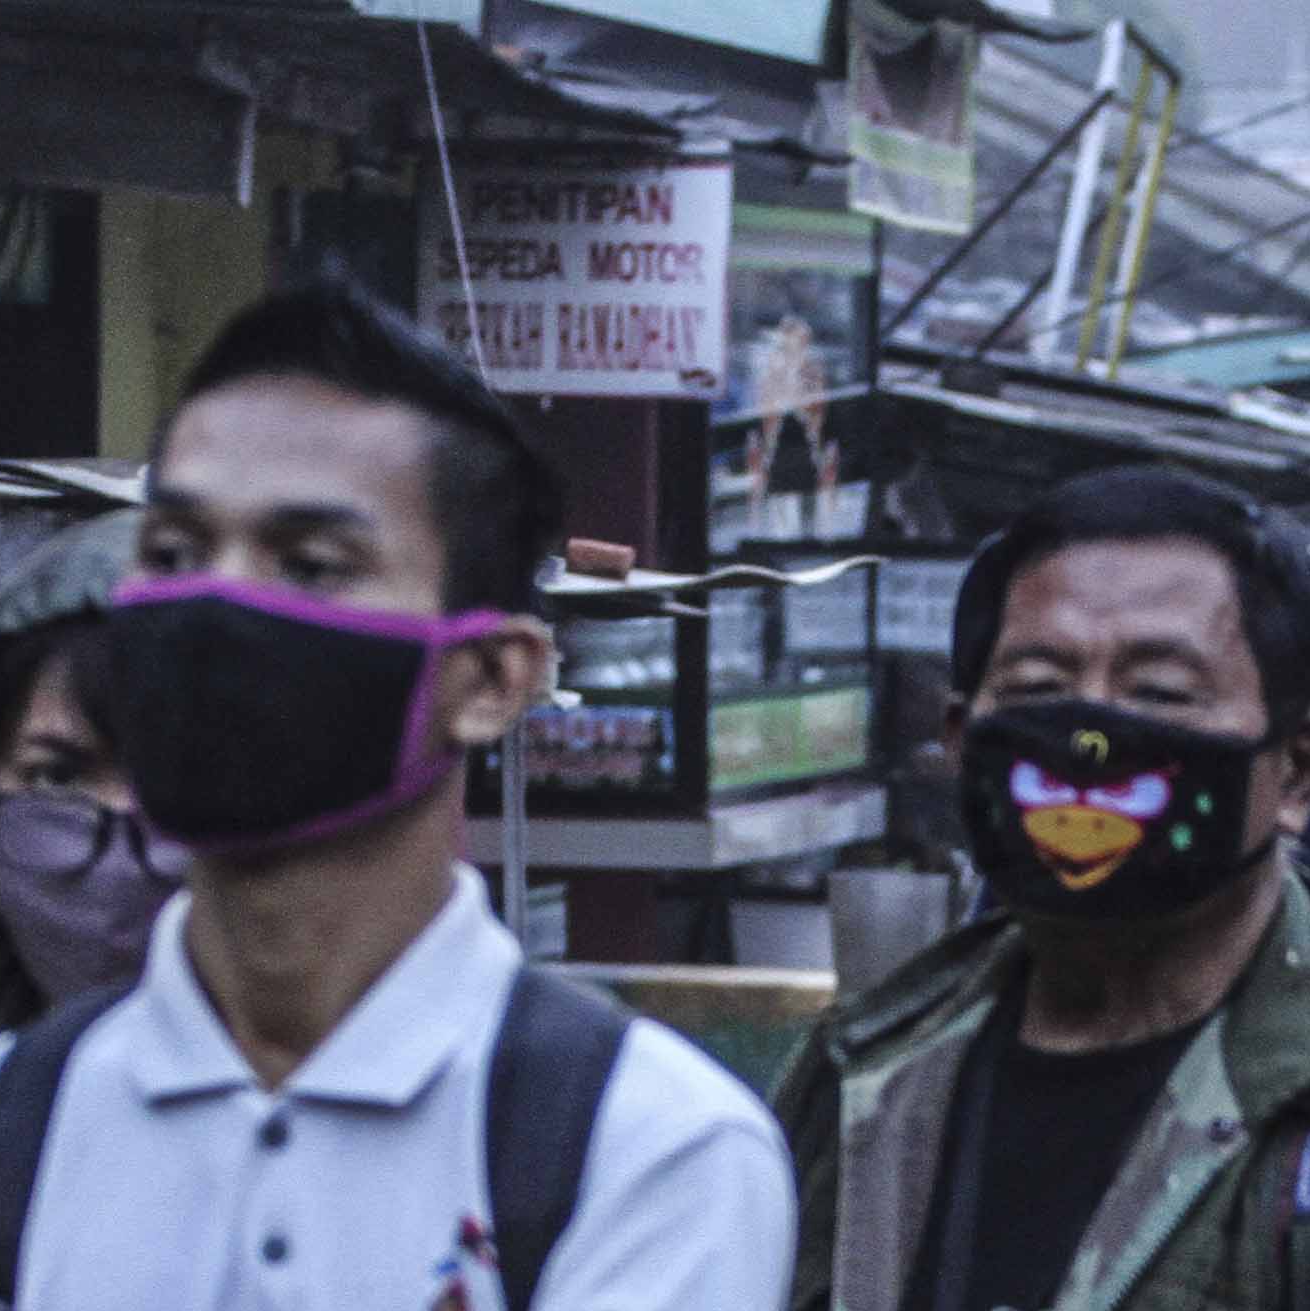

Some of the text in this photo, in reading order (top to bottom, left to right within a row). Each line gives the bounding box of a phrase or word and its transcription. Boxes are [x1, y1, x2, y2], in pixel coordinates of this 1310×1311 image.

[471, 182, 675, 224] PENITIPAN
[437, 240, 705, 283] SEPEDA MOTOR
[556, 302, 706, 371] RAMADHAN
